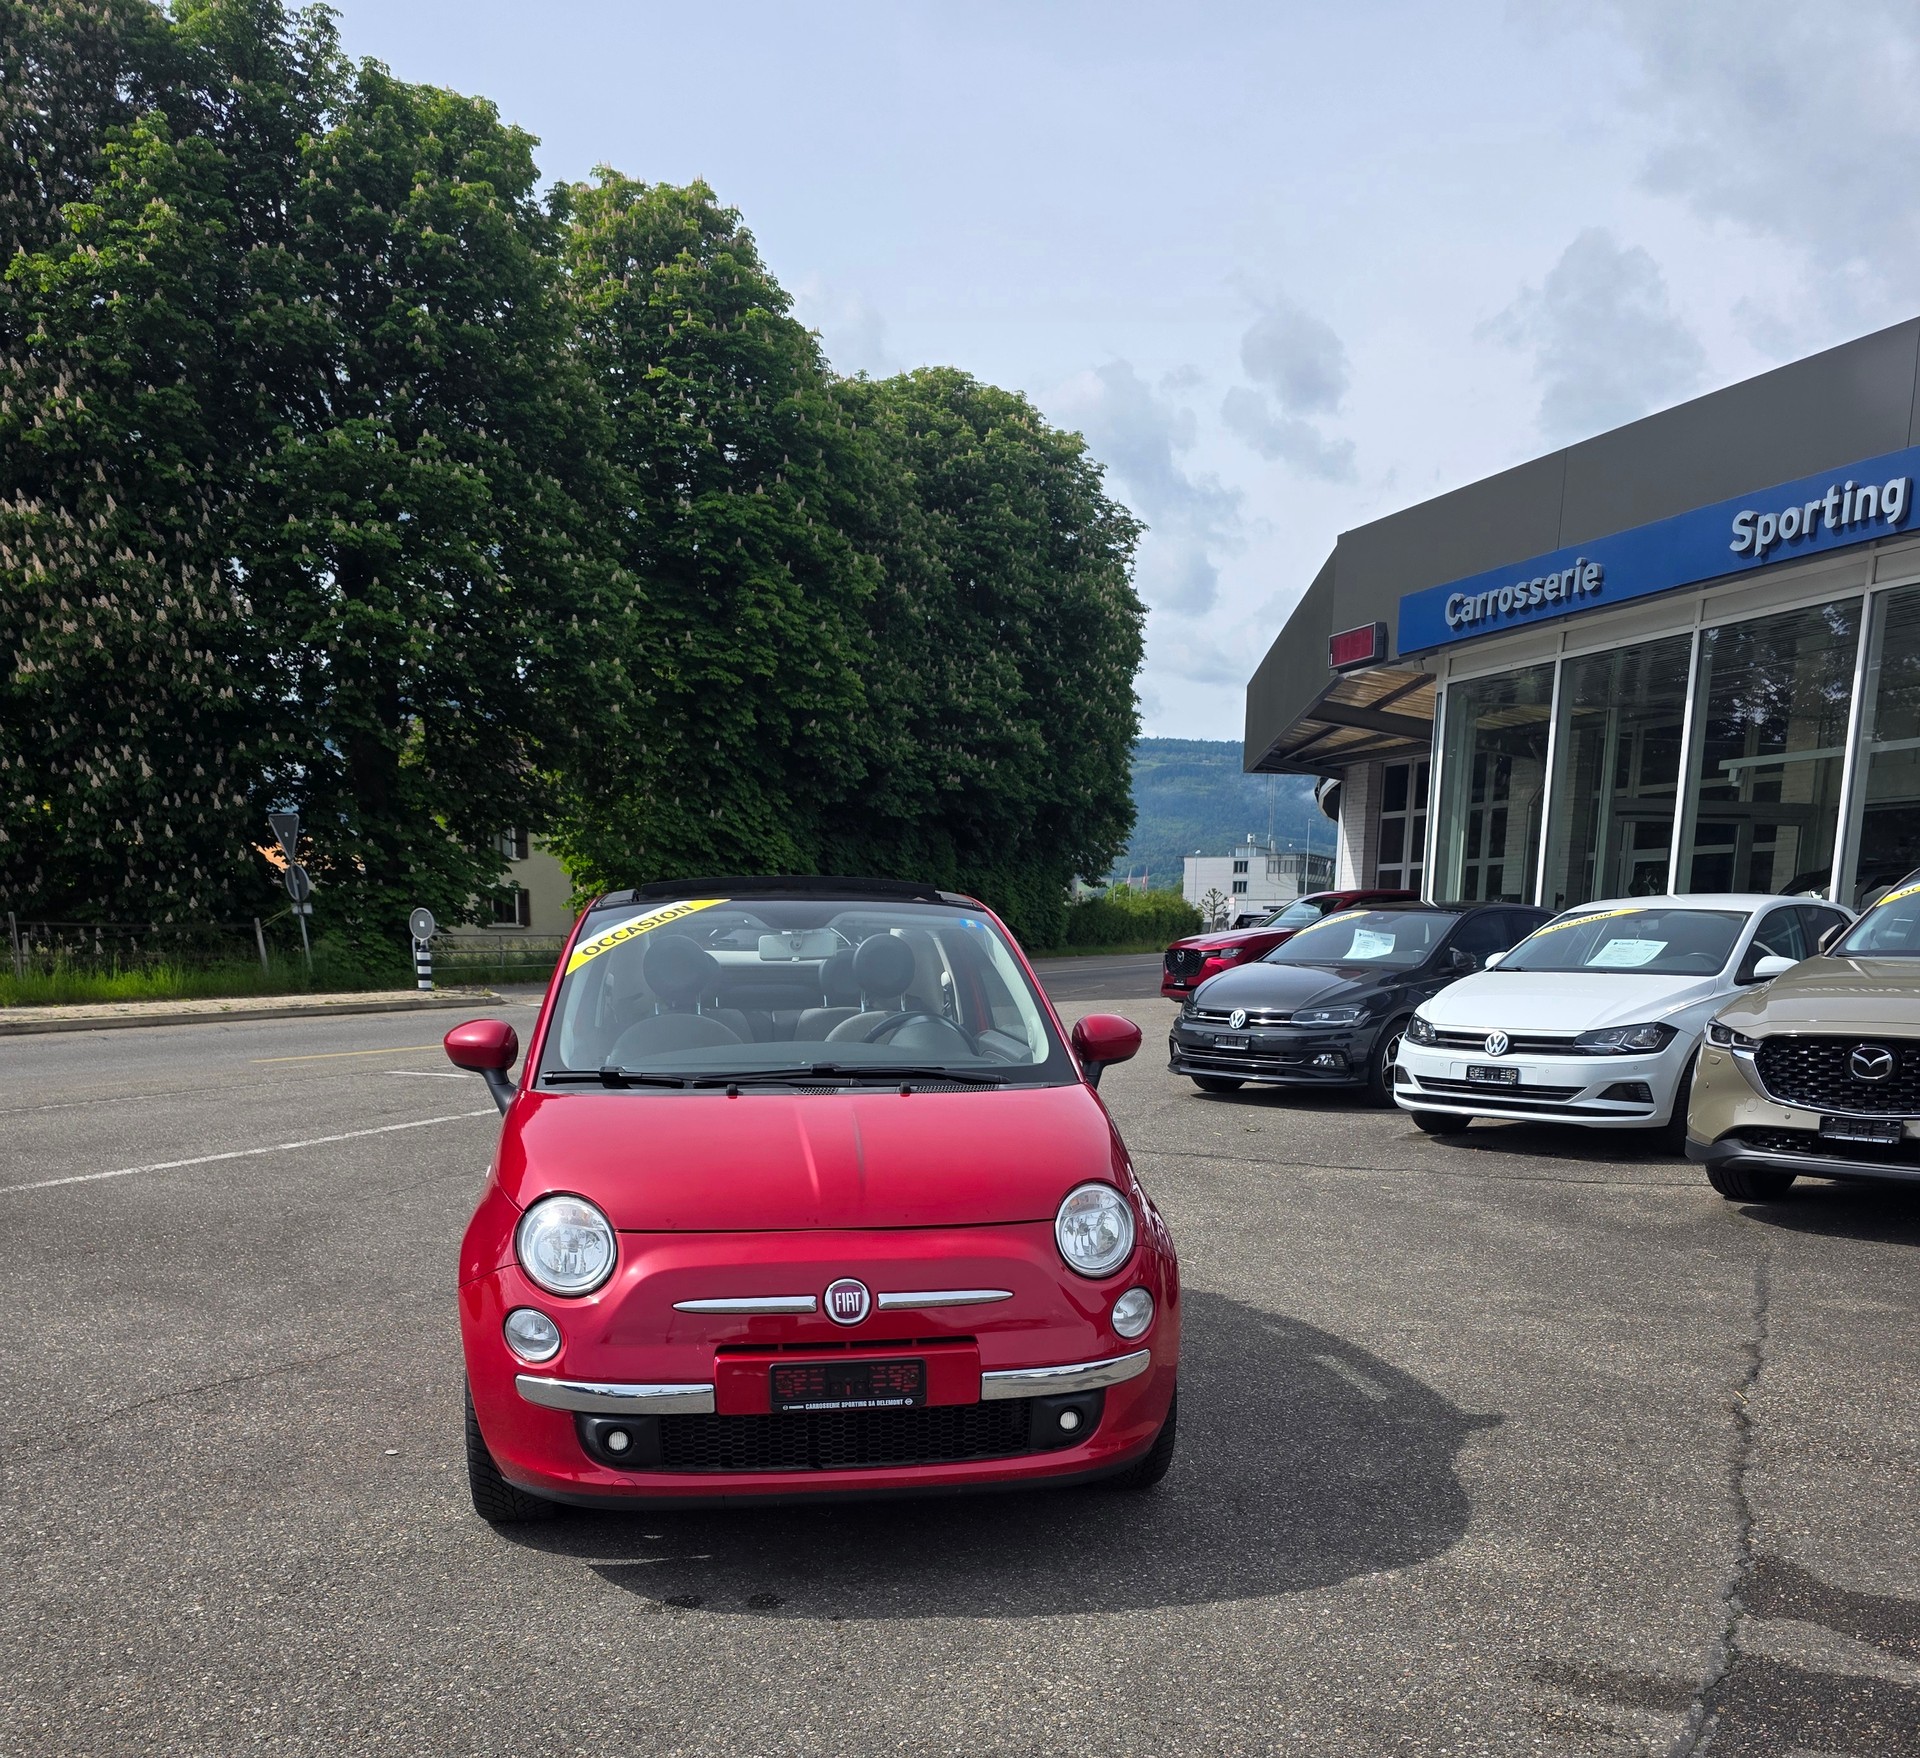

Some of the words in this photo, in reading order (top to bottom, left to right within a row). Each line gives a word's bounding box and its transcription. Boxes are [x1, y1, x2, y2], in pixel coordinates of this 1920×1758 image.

[1445, 557, 1602, 626] Carrosserie
[1729, 477, 1911, 557] Sporting
[582, 905, 694, 956] OCCASION
[1552, 912, 1612, 931] OCCASION
[835, 1292, 861, 1312] FIAT
[805, 1402, 840, 1410] CARROSSERIE
[841, 1400, 867, 1408] SPORTING
